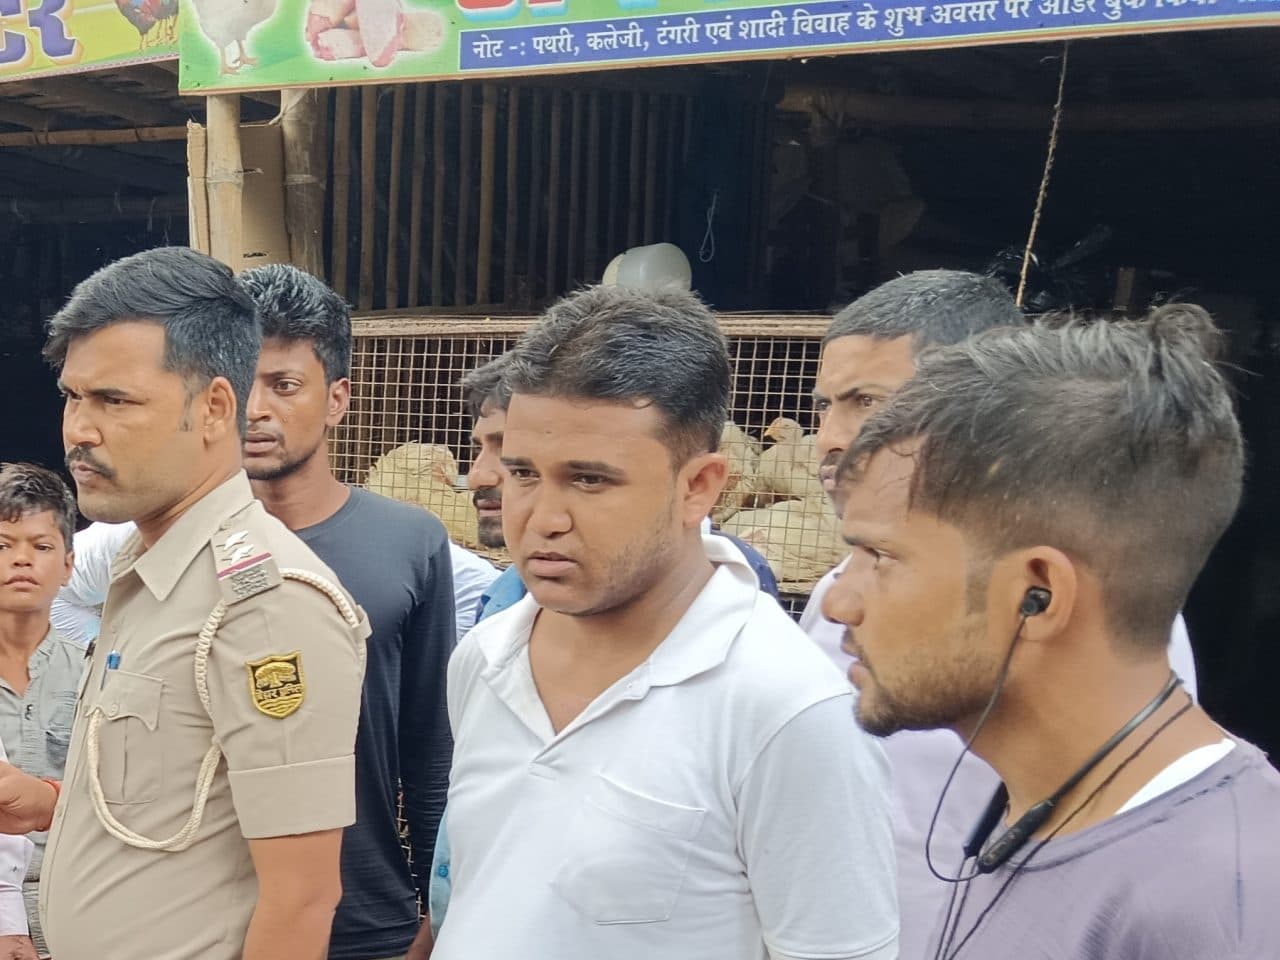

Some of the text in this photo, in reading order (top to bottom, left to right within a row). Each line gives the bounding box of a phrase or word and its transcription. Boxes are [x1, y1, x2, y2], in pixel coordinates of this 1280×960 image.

[472, 34, 504, 58] नोट
[586, 23, 649, 51] कलेजी,
[656, 17, 701, 45] टंगरी
[705, 15, 734, 44] एवं
[738, 10, 788, 39] शादी
[792, 8, 852, 36] विवाह
[856, 3, 879, 30] के
[884, 6, 926, 36] शुभ
[930, 1, 999, 25] अवसर
